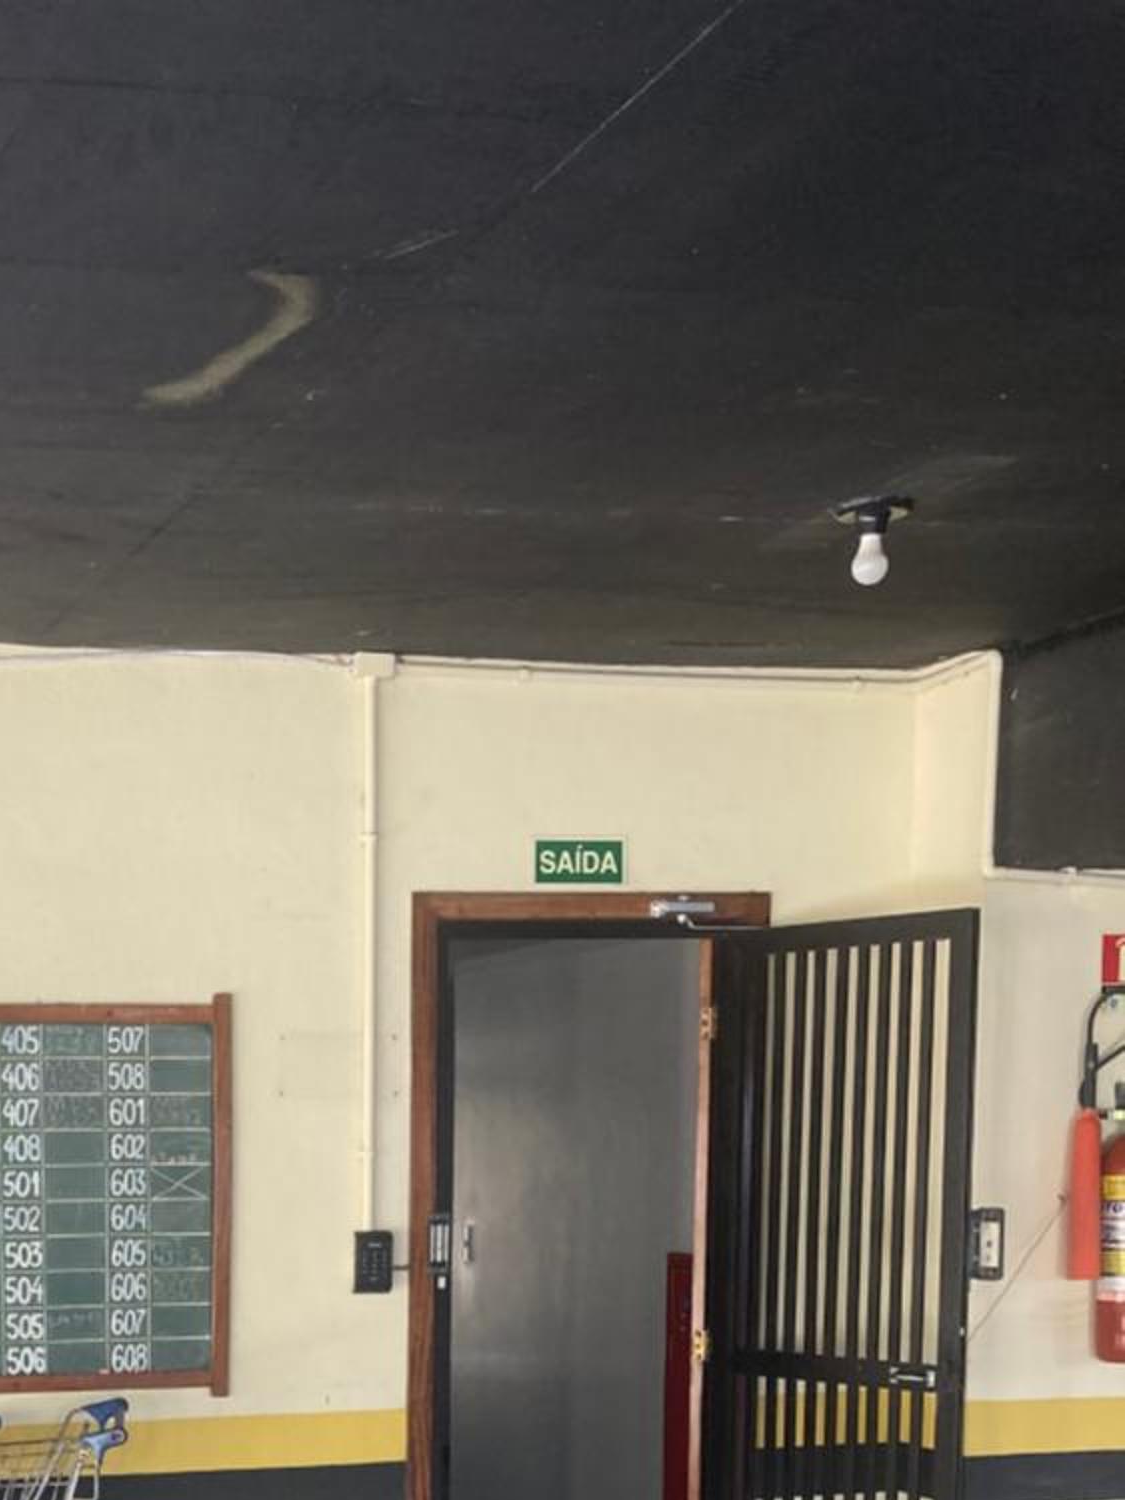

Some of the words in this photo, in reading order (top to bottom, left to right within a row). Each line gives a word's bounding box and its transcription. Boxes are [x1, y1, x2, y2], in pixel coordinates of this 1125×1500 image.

[539, 844, 618, 874] SAÍDA
[2, 1026, 39, 1053] 405
[108, 1028, 142, 1053] 507
[2, 1064, 39, 1090] 406
[109, 1063, 144, 1090] 508
[3, 1099, 39, 1127] 407
[110, 1099, 145, 1125] 601
[3, 1136, 40, 1161] 408
[111, 1135, 144, 1159] 602
[3, 1171, 39, 1196] 501
[111, 1169, 145, 1194] 603
[4, 1207, 40, 1232] 502
[111, 1204, 145, 1230] 604
[6, 1242, 42, 1268] 503
[112, 1240, 145, 1265] 605
[6, 1278, 43, 1304] 504
[111, 1274, 145, 1301] 606
[6, 1314, 44, 1339] 505
[111, 1310, 145, 1335] 607
[7, 1347, 46, 1374] 506
[112, 1345, 147, 1373] 608
